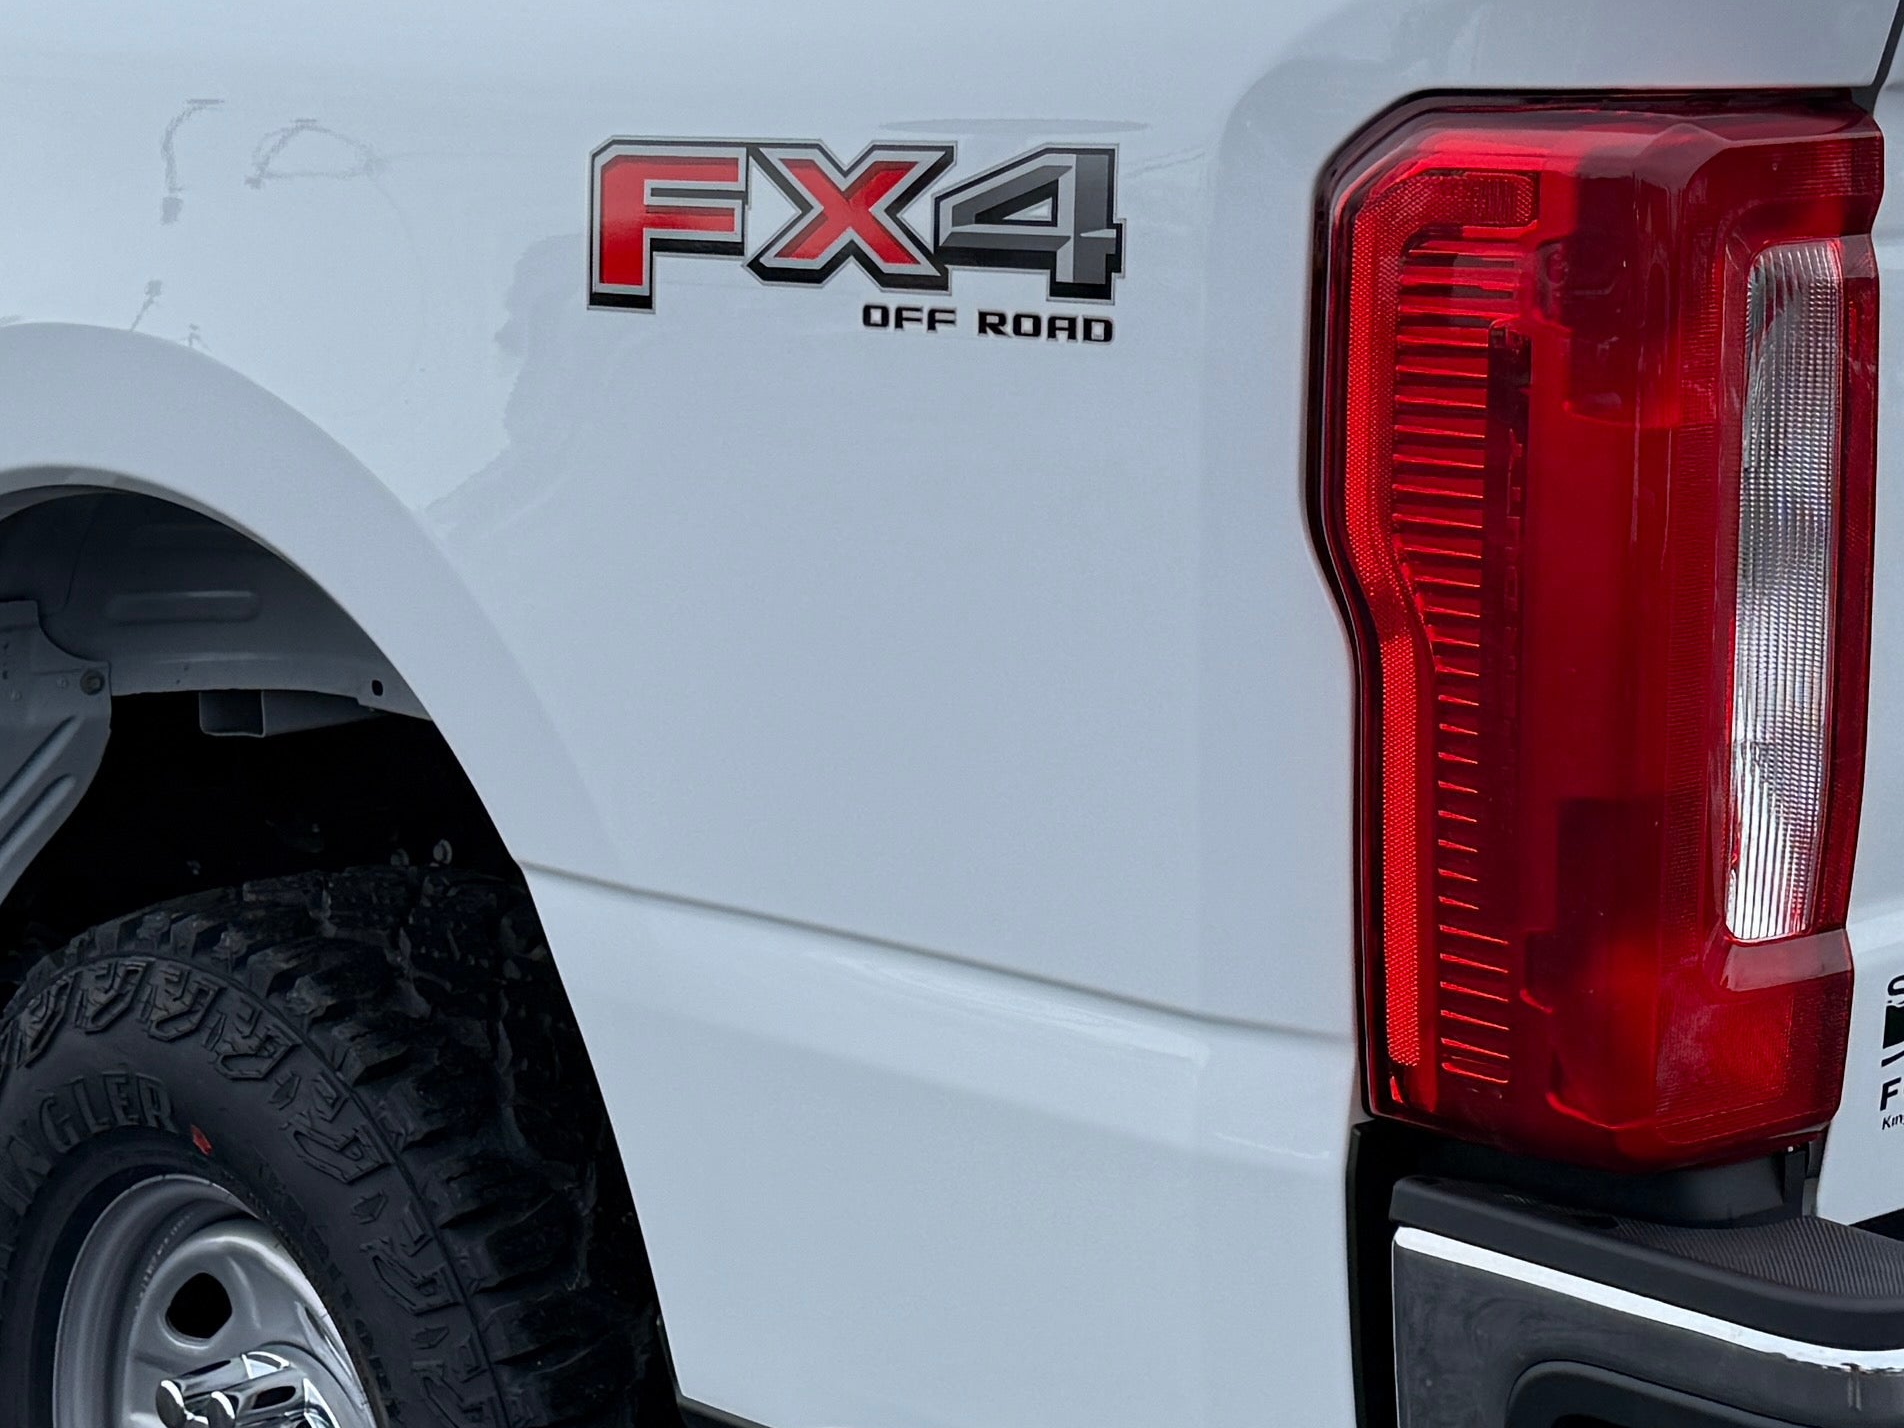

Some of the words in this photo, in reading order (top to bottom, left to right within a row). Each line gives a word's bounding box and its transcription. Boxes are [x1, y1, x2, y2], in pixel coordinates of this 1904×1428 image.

[586, 135, 1125, 312] FX4
[861, 303, 958, 332] OFF
[976, 309, 1115, 344] ROAD
